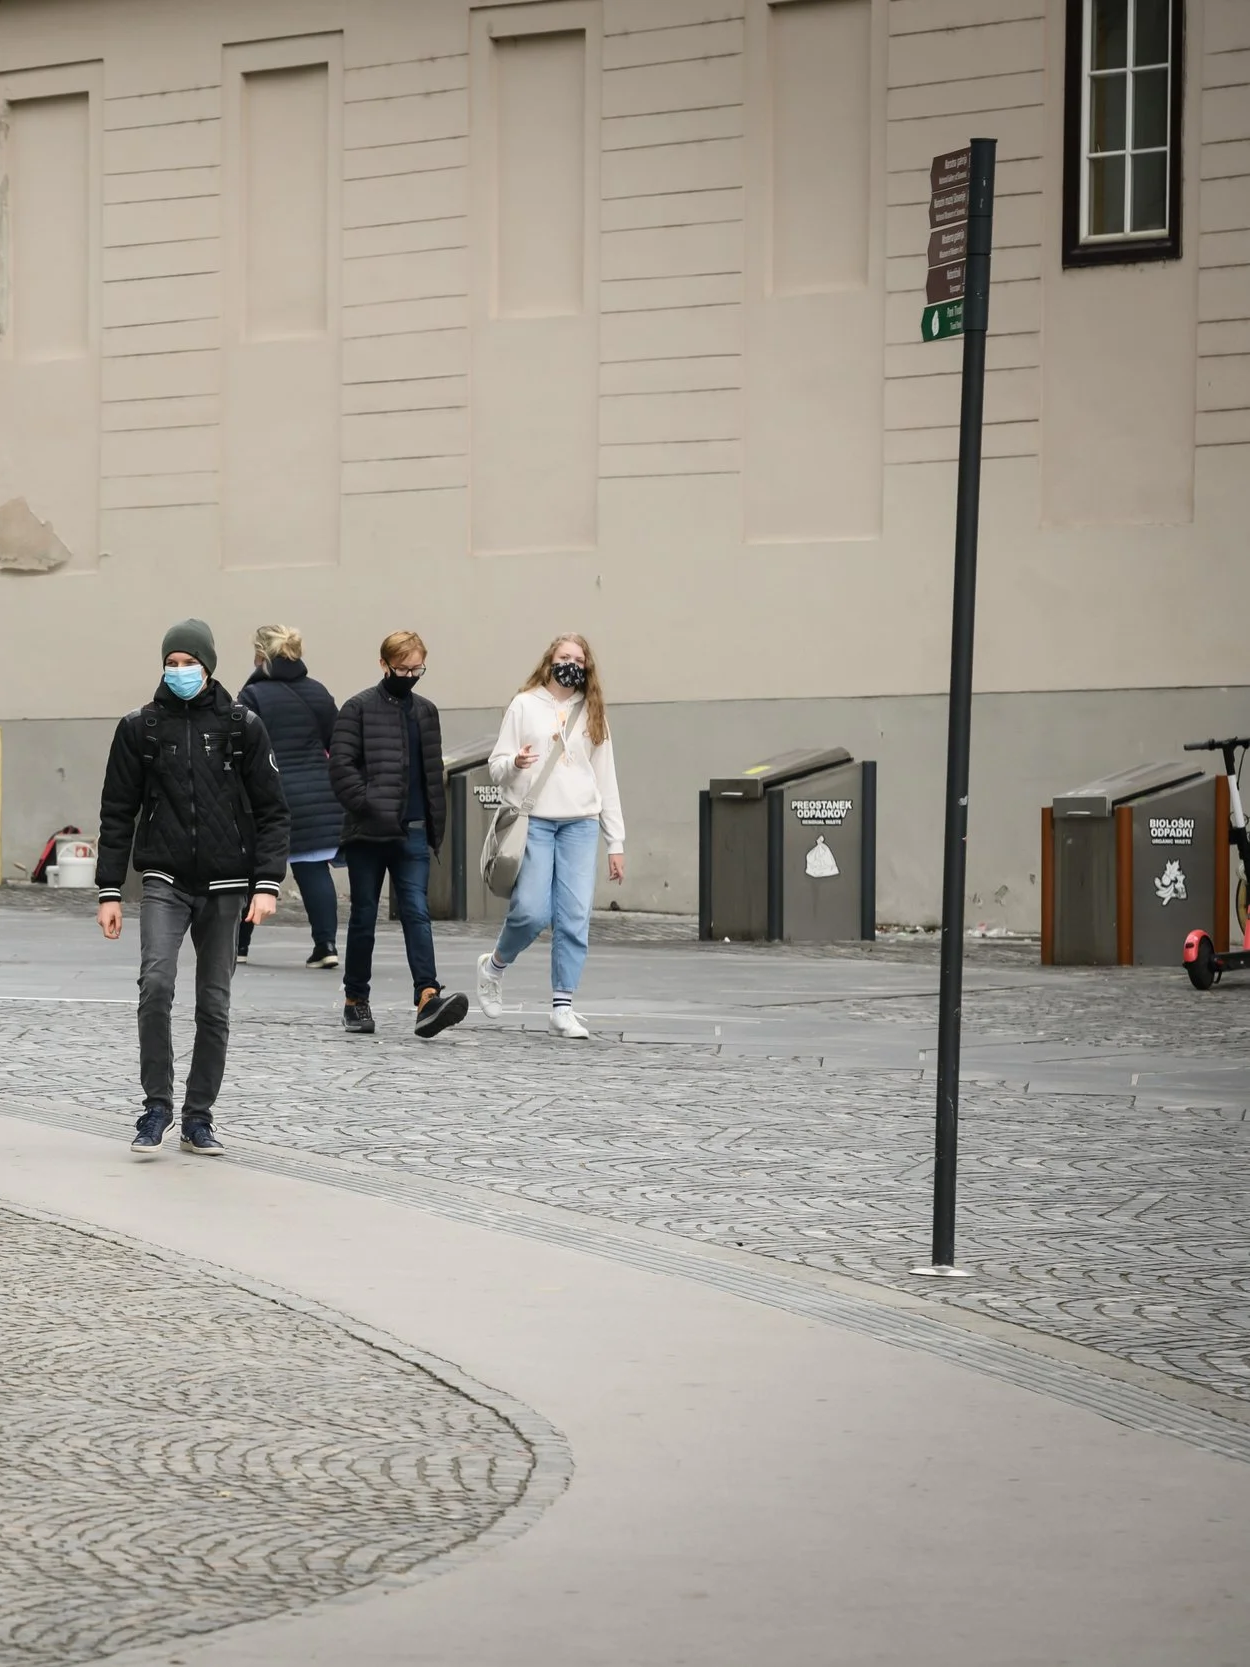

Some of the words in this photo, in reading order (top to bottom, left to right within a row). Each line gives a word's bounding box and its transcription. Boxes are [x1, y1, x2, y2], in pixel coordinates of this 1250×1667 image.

[473, 786, 503, 794] PREOS
[479, 794, 503, 802] ODPA
[791, 801, 852, 809] PREOSTANEK
[797, 810, 847, 818] ODPADKOV
[1149, 818, 1194, 828] BIOLOŠKI
[1151, 828, 1193, 837] ODPADKI
